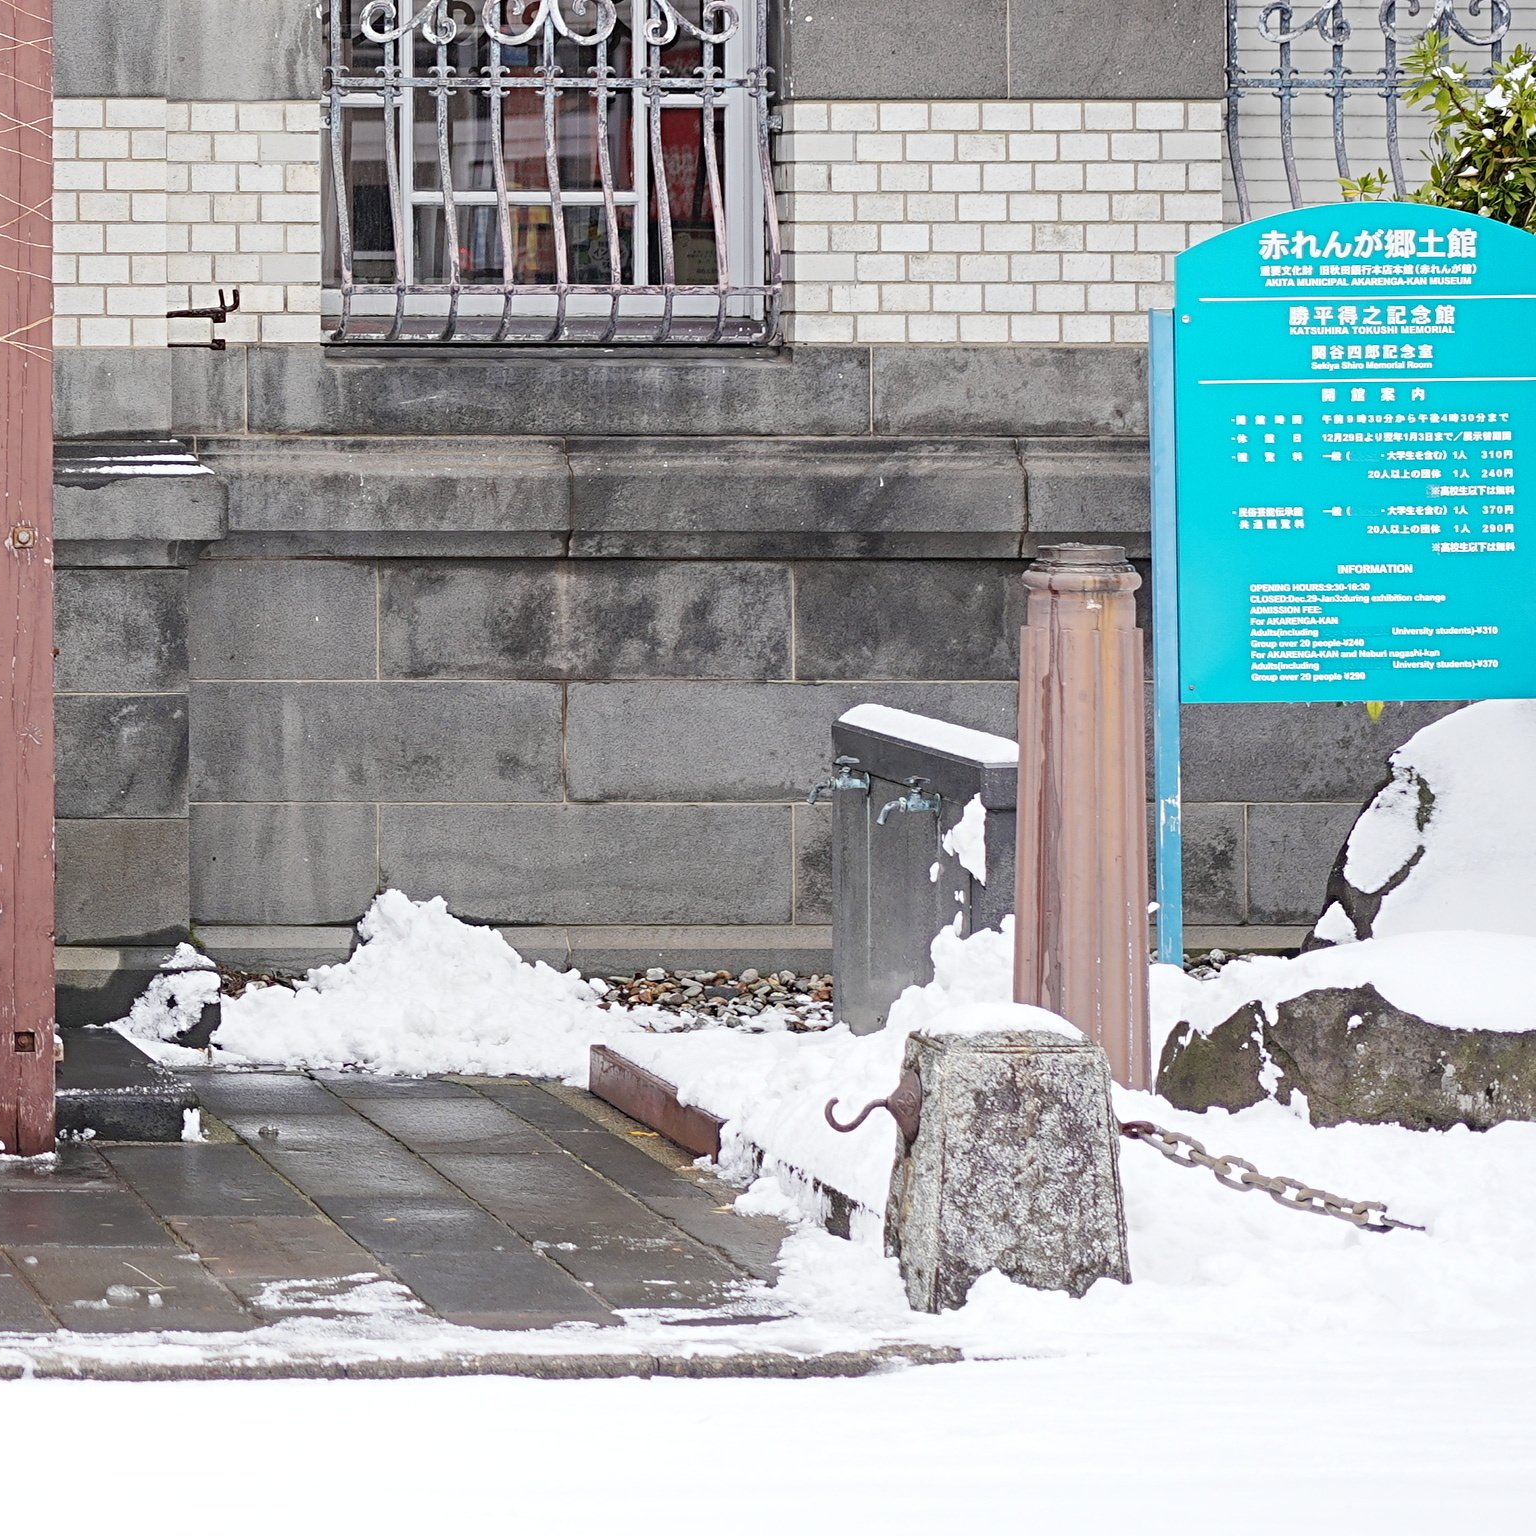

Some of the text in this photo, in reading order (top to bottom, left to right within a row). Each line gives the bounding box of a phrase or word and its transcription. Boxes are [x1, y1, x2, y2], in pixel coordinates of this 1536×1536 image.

[1258, 228, 1478, 260] 赤れんが郷土館
[1260, 265, 1313, 277] 重要文化財
[1265, 276, 1472, 287] AKITA MUNICIPAL AKARENGA-KAN MUSEUM
[1288, 305, 1456, 326] 勝平得之記念館
[1289, 325, 1456, 335] KATSUHIRA TOKUSHI MEMORIAL
[1311, 344, 1433, 360] 関谷四郎記念室
[1311, 361, 1433, 371] Sekiya Shiro Memorial Room
[1367, 469, 1442, 479] 20人以上の団体
[1367, 524, 1441, 534] 20人以上の団体
[1337, 563, 1414, 574] INFORMATION
[1249, 583, 1291, 592] OPENING
[1371, 594, 1413, 602] exhibition
[1414, 594, 1447, 603] change
[1250, 606, 1301, 614] ADMISSION
[1250, 617, 1339, 625] For AKARENGA-KAN
[1391, 627, 1434, 636] University
[1250, 640, 1277, 649] Group
[1299, 639, 1311, 647] 20
[1251, 651, 1265, 659] For
[1267, 650, 1339, 659] AKARENGA-KAN
[1340, 650, 1357, 658] and
[1392, 660, 1434, 670] University
[1251, 673, 1278, 682] Group
[1300, 673, 1311, 681] 20
[1312, 673, 1342, 682] people
